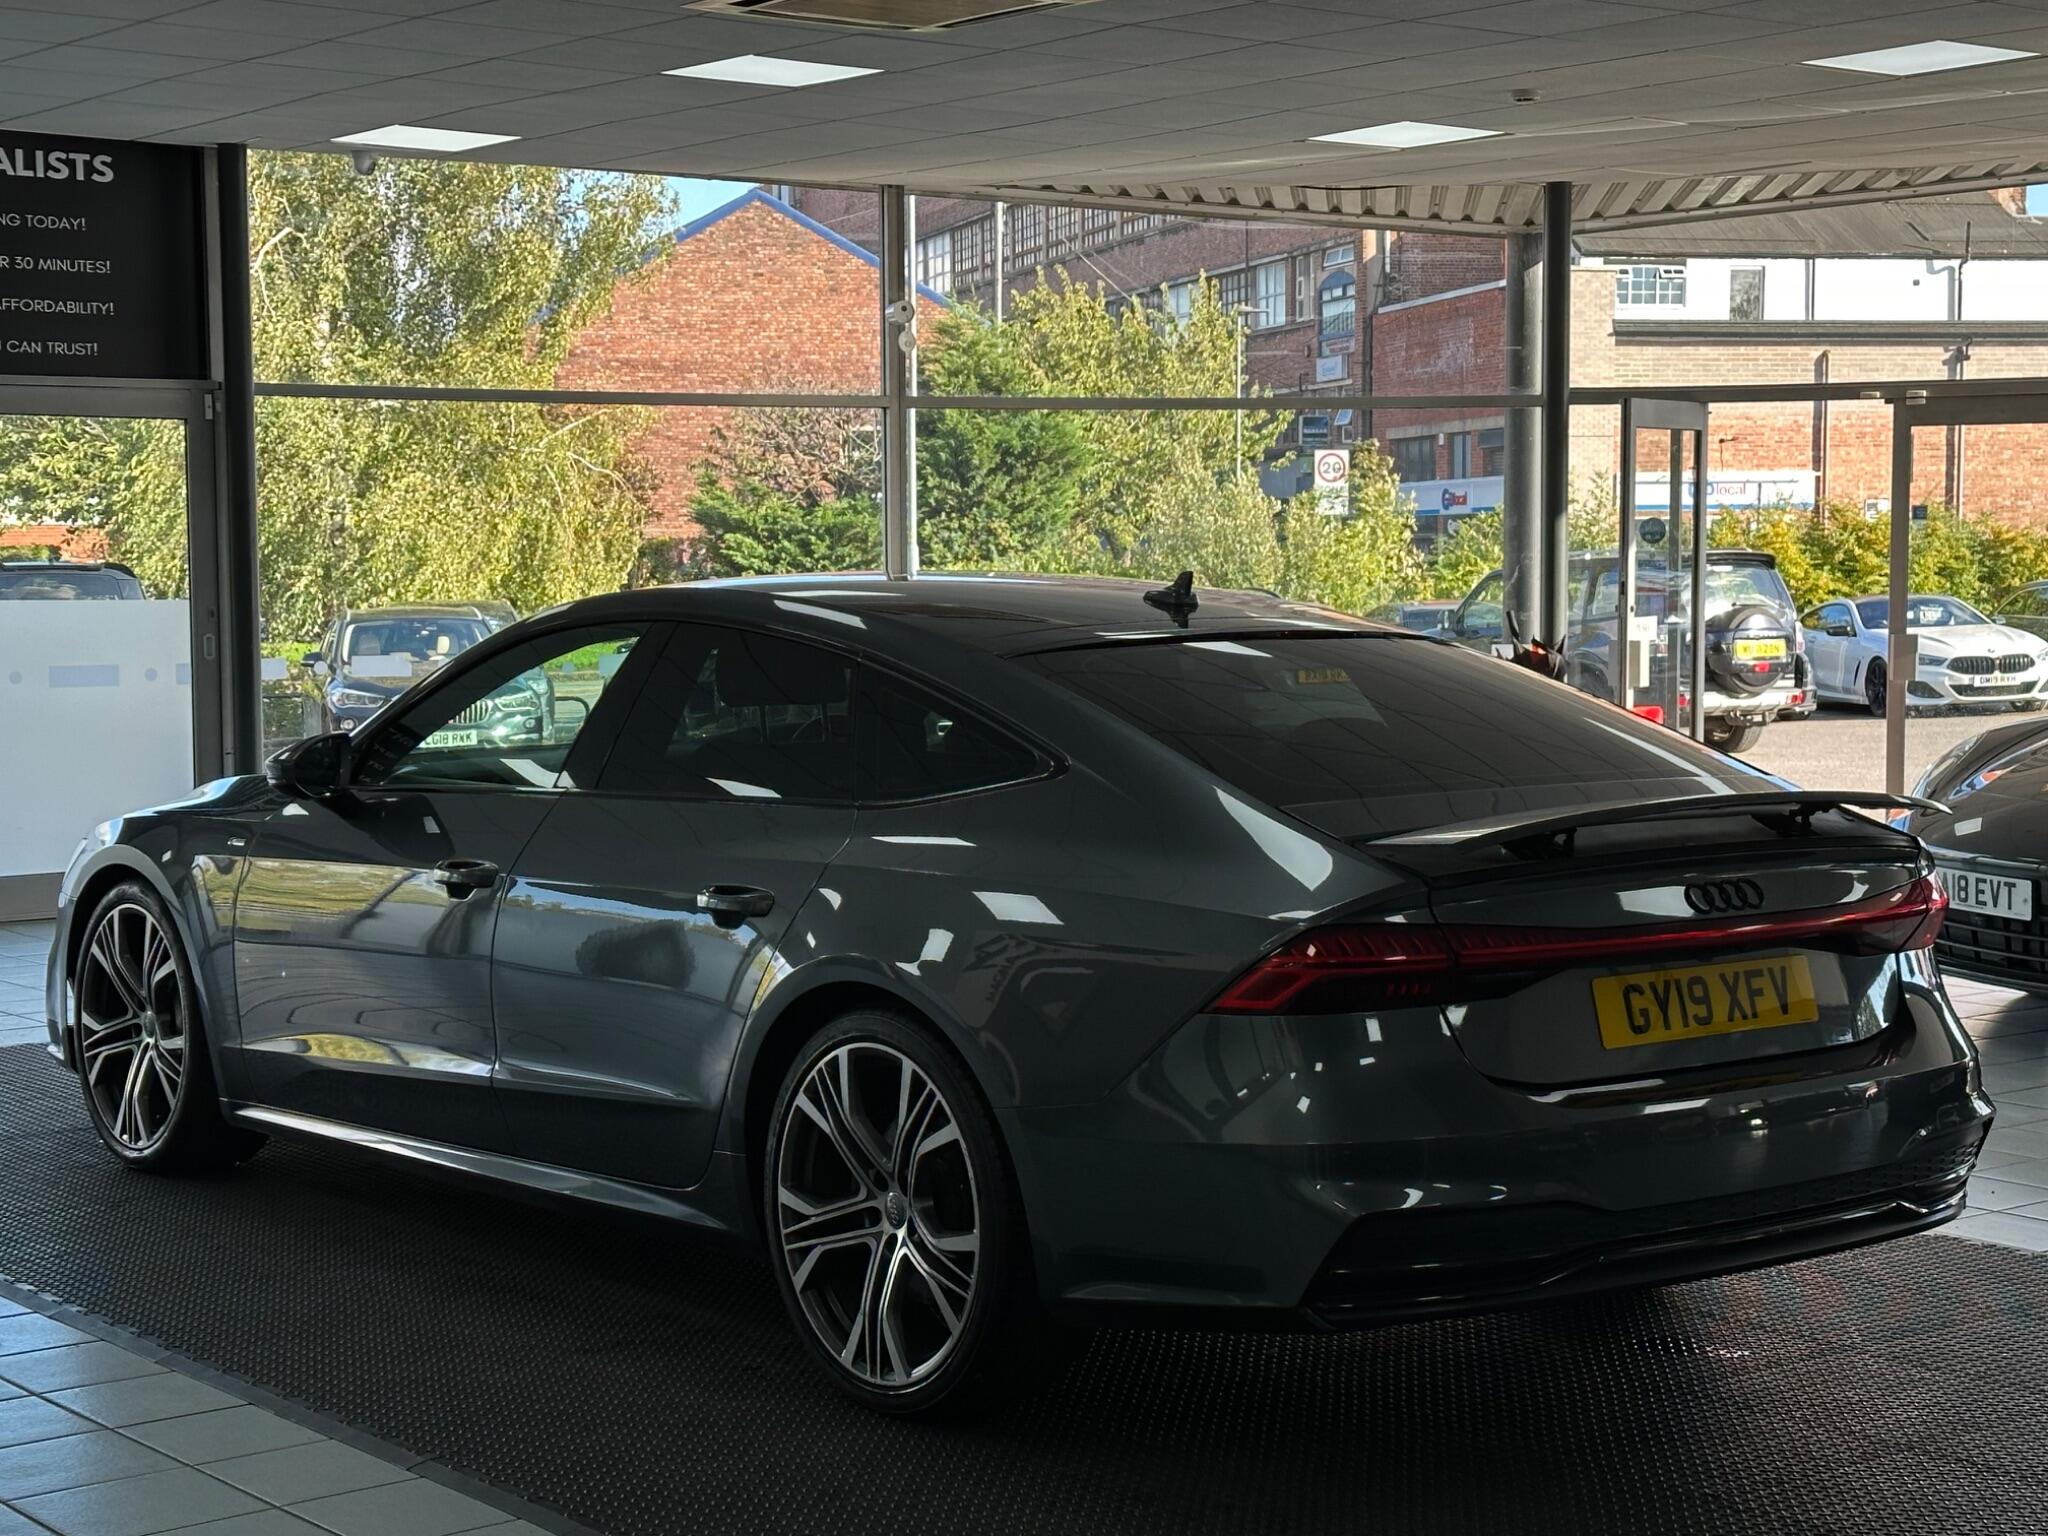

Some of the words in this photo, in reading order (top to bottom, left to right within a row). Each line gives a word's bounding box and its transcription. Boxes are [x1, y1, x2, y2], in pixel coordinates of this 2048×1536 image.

[0, 147, 114, 183] ALISTS
[25, 214, 87, 231] TODAY!
[14, 256, 34, 270] 30
[38, 258, 111, 274] MINUTES!
[0, 298, 114, 316] FFORDABILITY!
[6, 340, 42, 353] CAN
[46, 341, 98, 356] TRUST!
[1322, 461, 1342, 474] 20
[1716, 482, 1746, 496] local
[1975, 877, 2017, 911] EVT
[1621, 974, 1715, 1036] GY19
[1718, 965, 1790, 1023] XFV
